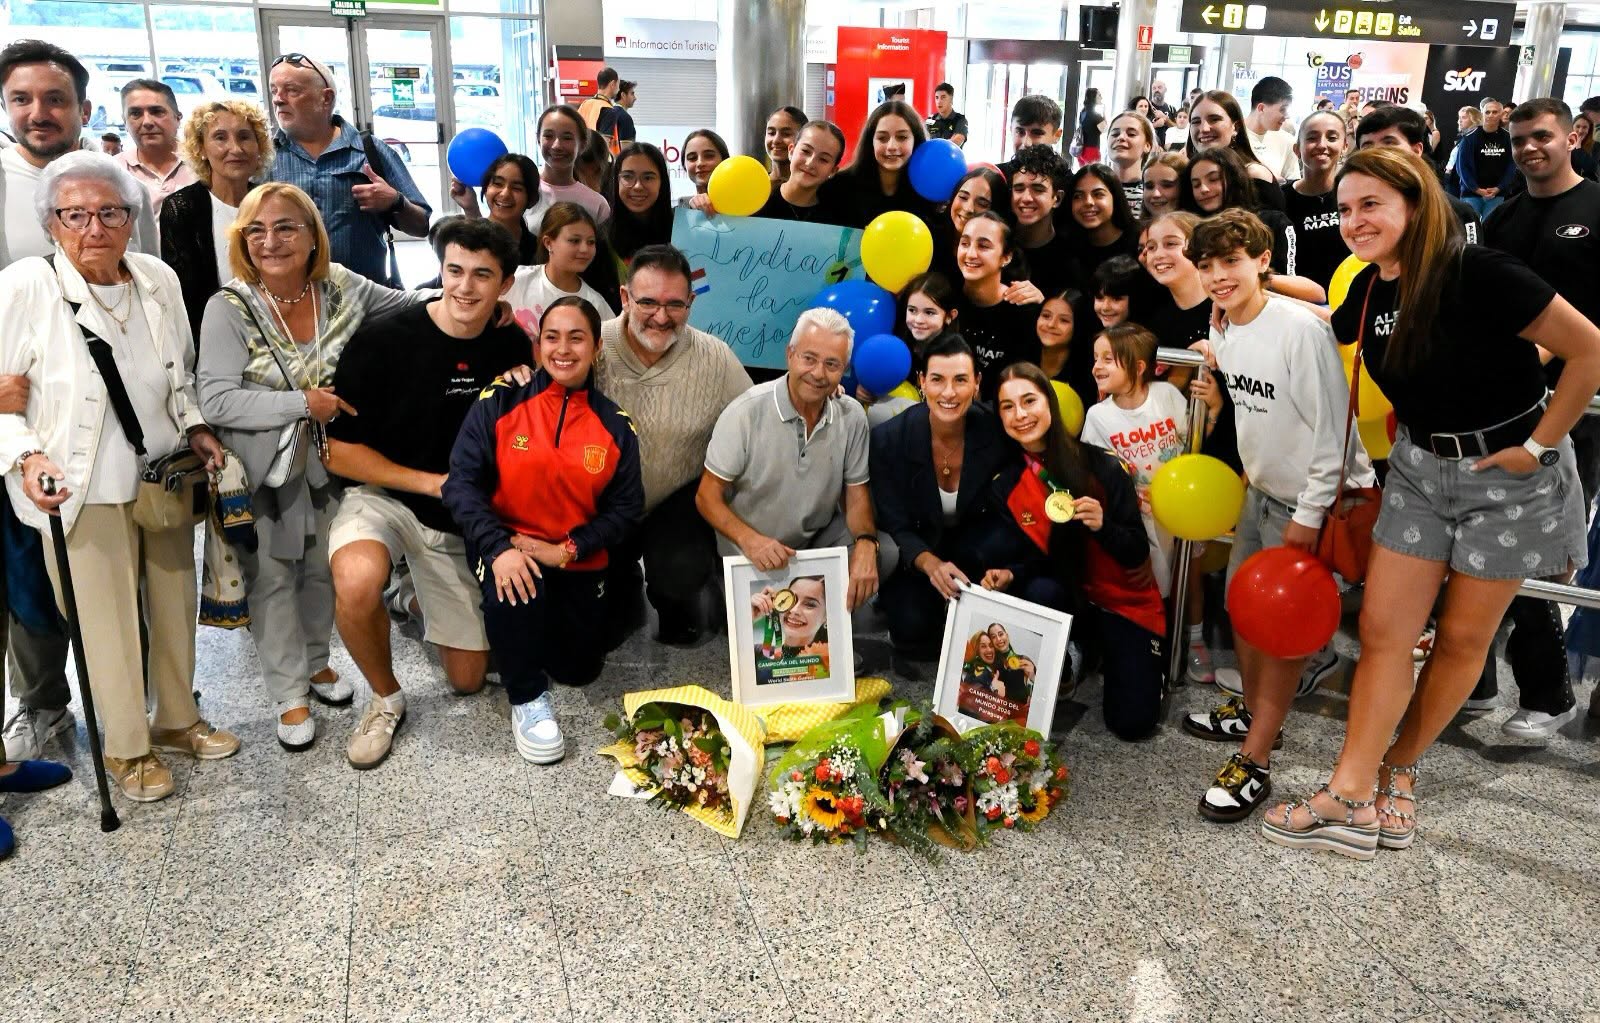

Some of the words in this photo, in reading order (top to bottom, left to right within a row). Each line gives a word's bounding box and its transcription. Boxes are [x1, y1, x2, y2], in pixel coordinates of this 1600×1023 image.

[332, 8, 365, 16] EMERGENCIA
[1397, 25, 1420, 36] Salida
[629, 38, 683, 50] Información
[877, 43, 910, 51] Information
[1318, 65, 1351, 80] BUS
[1358, 86, 1409, 104] BEGINS
[1303, 211, 1339, 224] ALEX
[1304, 219, 1340, 231] MAR
[688, 225, 838, 281] India
[735, 275, 807, 315] la
[706, 320, 797, 359] mejo
[1109, 418, 1176, 449] FLOWER
[968, 687, 1008, 706] CAMPEONATO
[1008, 702, 1020, 711] DEL
[974, 697, 997, 710] MUNDO
